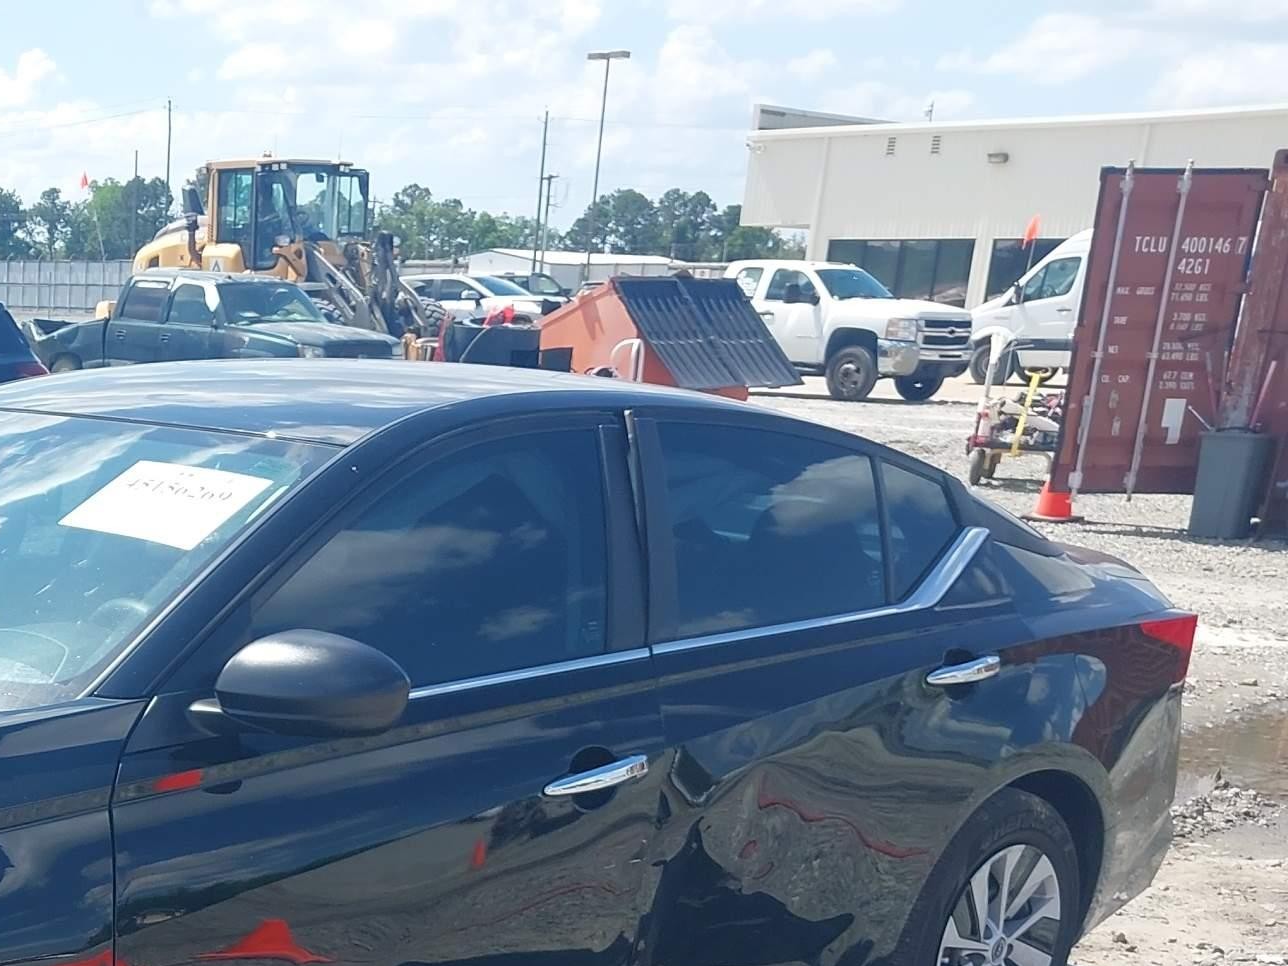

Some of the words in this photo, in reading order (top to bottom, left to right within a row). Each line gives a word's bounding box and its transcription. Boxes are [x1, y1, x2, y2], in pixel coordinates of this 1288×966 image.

[1135, 236, 1168, 253] TCLU
[1181, 236, 1232, 254] 400146
[1237, 236, 1249, 254] 7
[1177, 258, 1211, 275] 42G1
